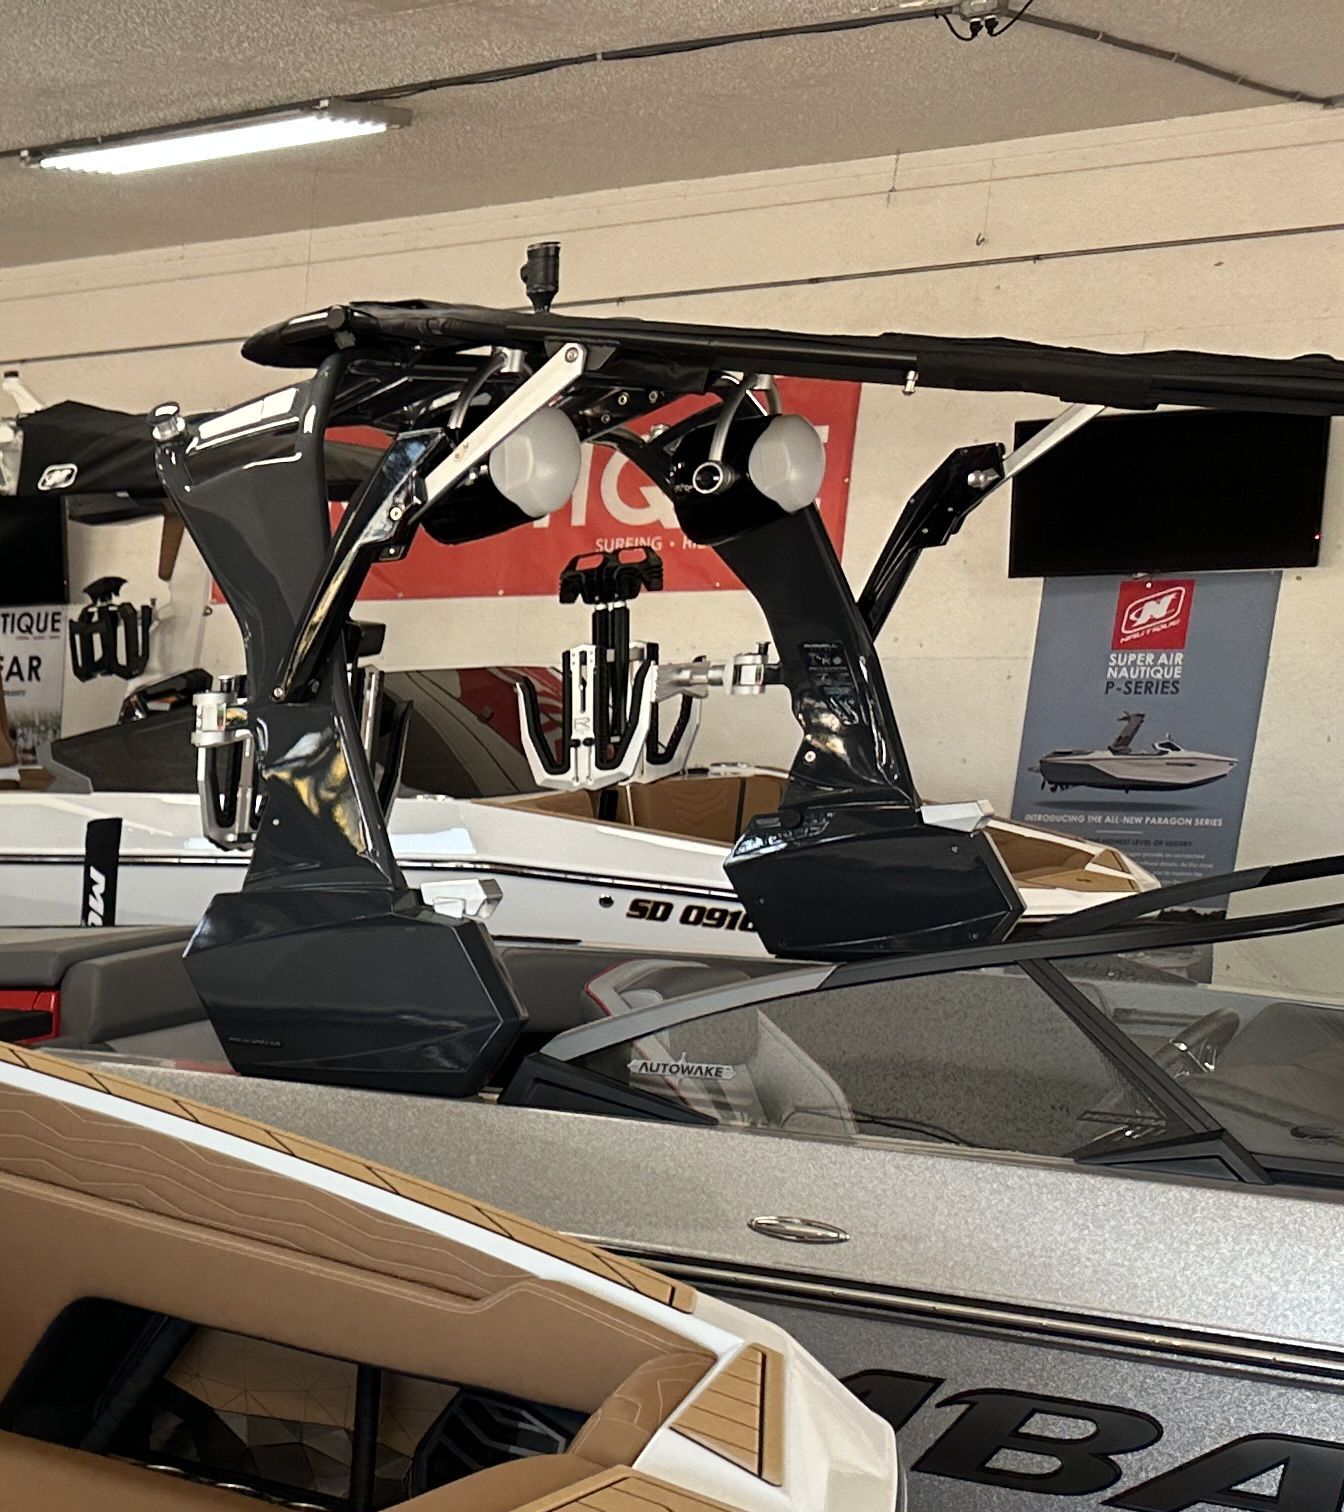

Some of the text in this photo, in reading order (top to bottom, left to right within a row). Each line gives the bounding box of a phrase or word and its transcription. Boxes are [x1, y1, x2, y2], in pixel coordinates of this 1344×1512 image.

[1108, 652, 1184, 666] SUPER AIR
[1106, 666, 1183, 679] NAUTIQUE
[1104, 680, 1180, 695] P-SERIES
[1024, 813, 1223, 827] INTRODUCING THE ALL-NEW PARAGON SERIES
[626, 898, 674, 922] SD
[638, 1062, 724, 1077] AUTOWAKE
